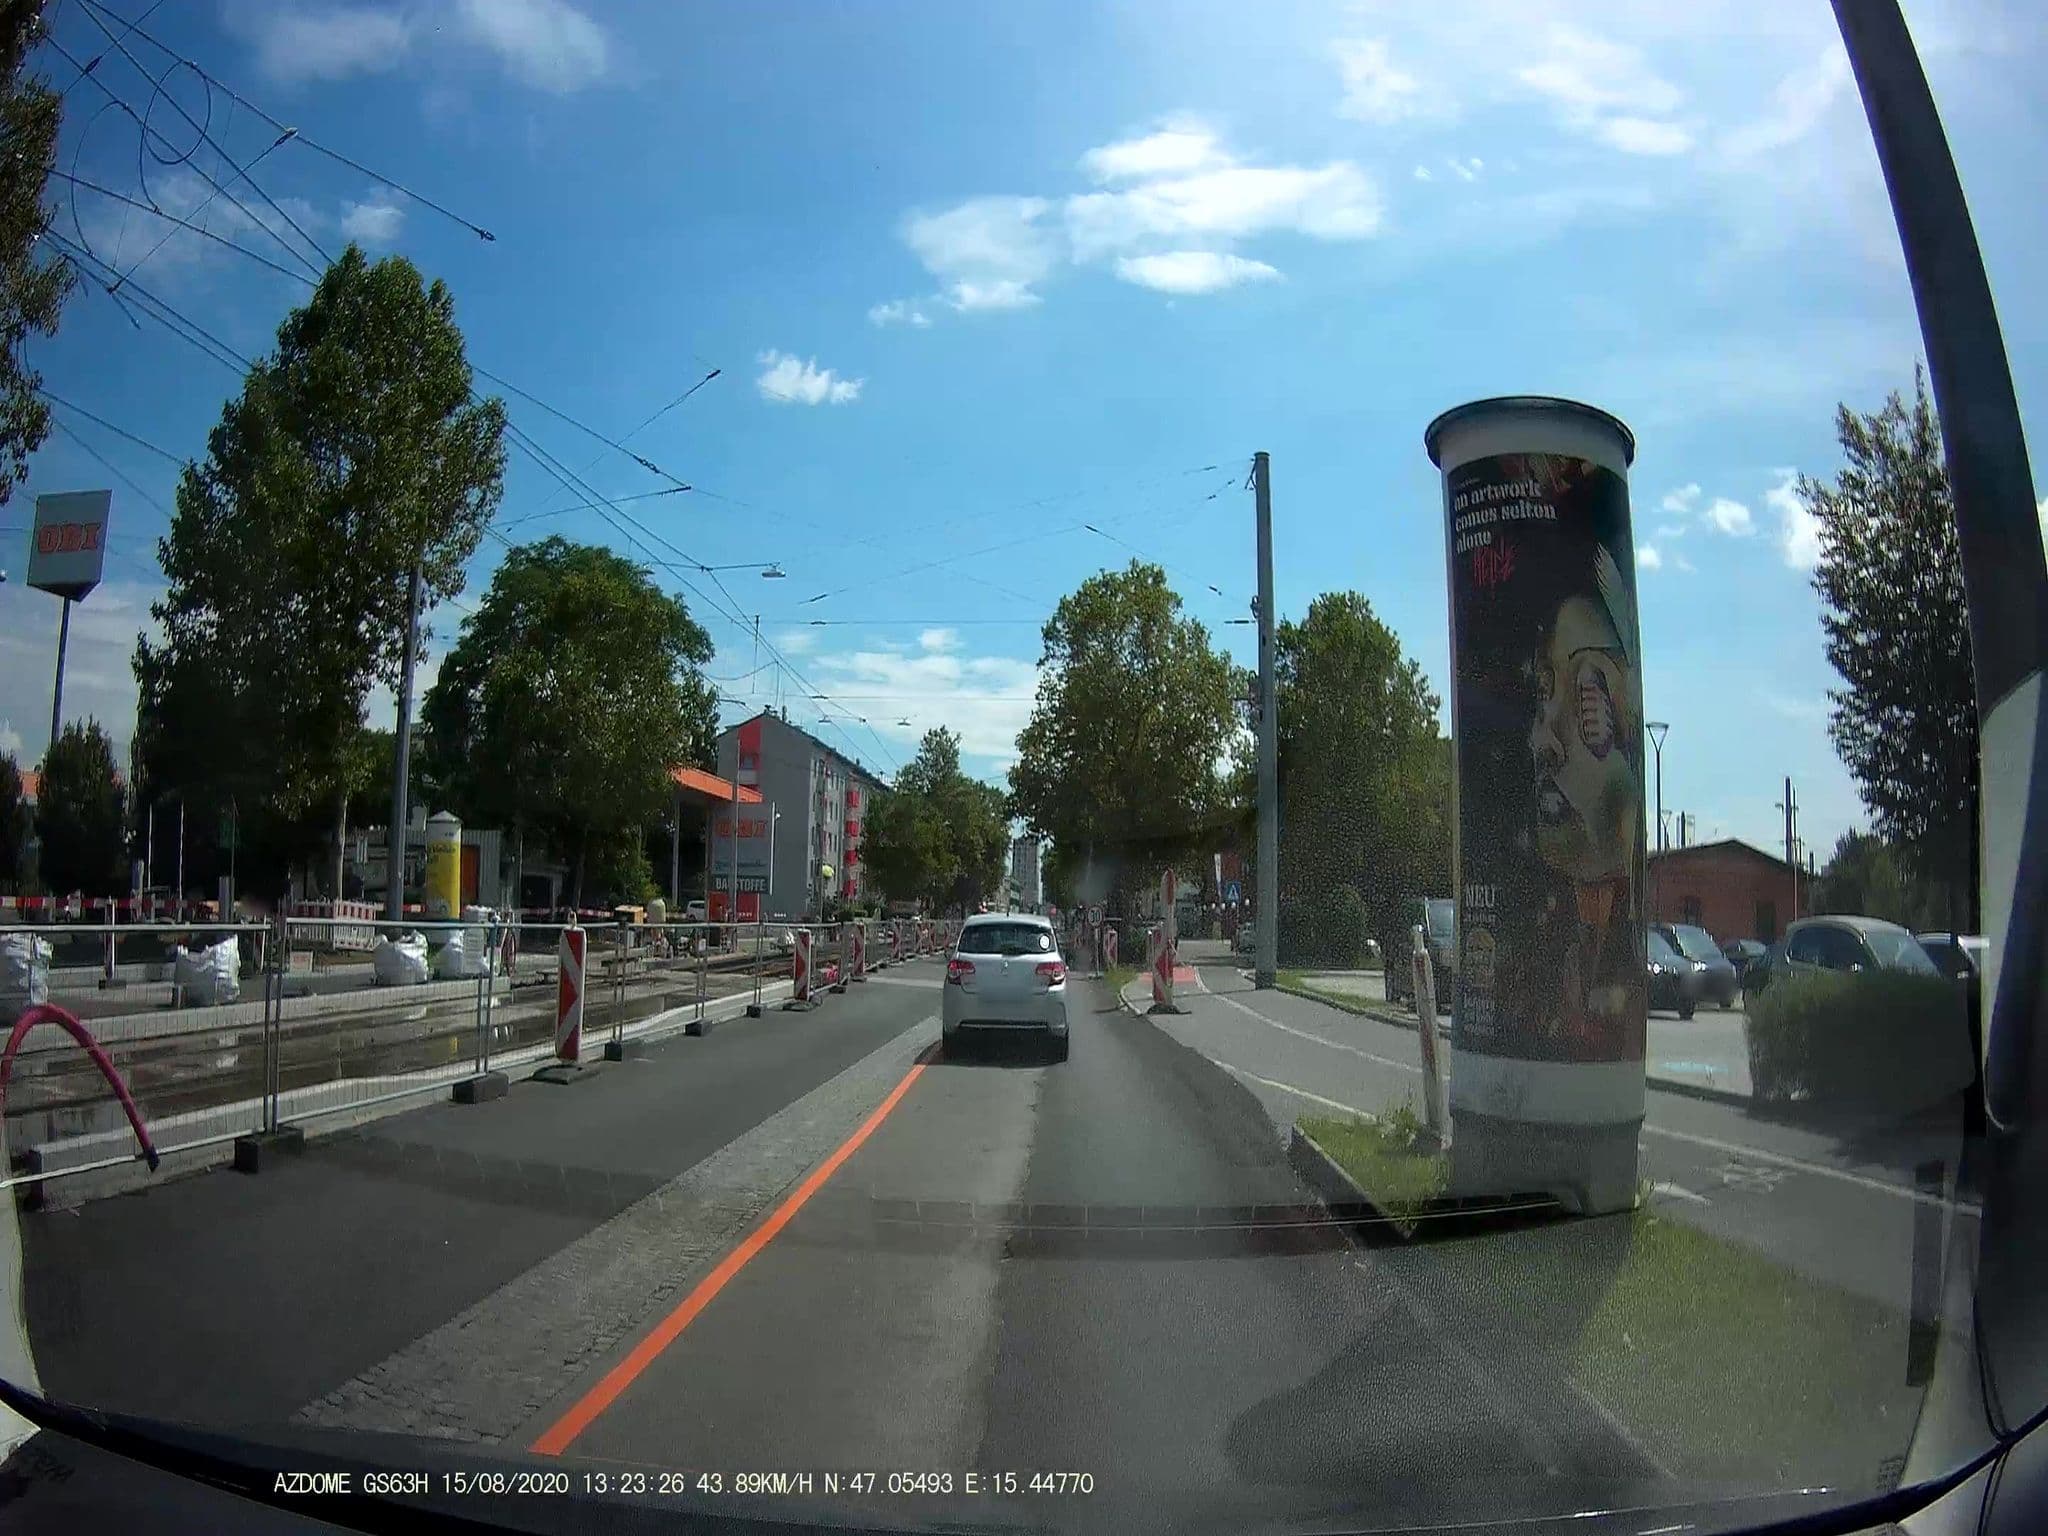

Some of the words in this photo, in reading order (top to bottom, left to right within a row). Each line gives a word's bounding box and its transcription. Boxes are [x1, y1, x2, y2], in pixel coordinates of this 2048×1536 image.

[1471, 480, 1542, 504] artwork
[39, 523, 100, 553] OBI
[715, 878, 766, 892] BASTOFFE
